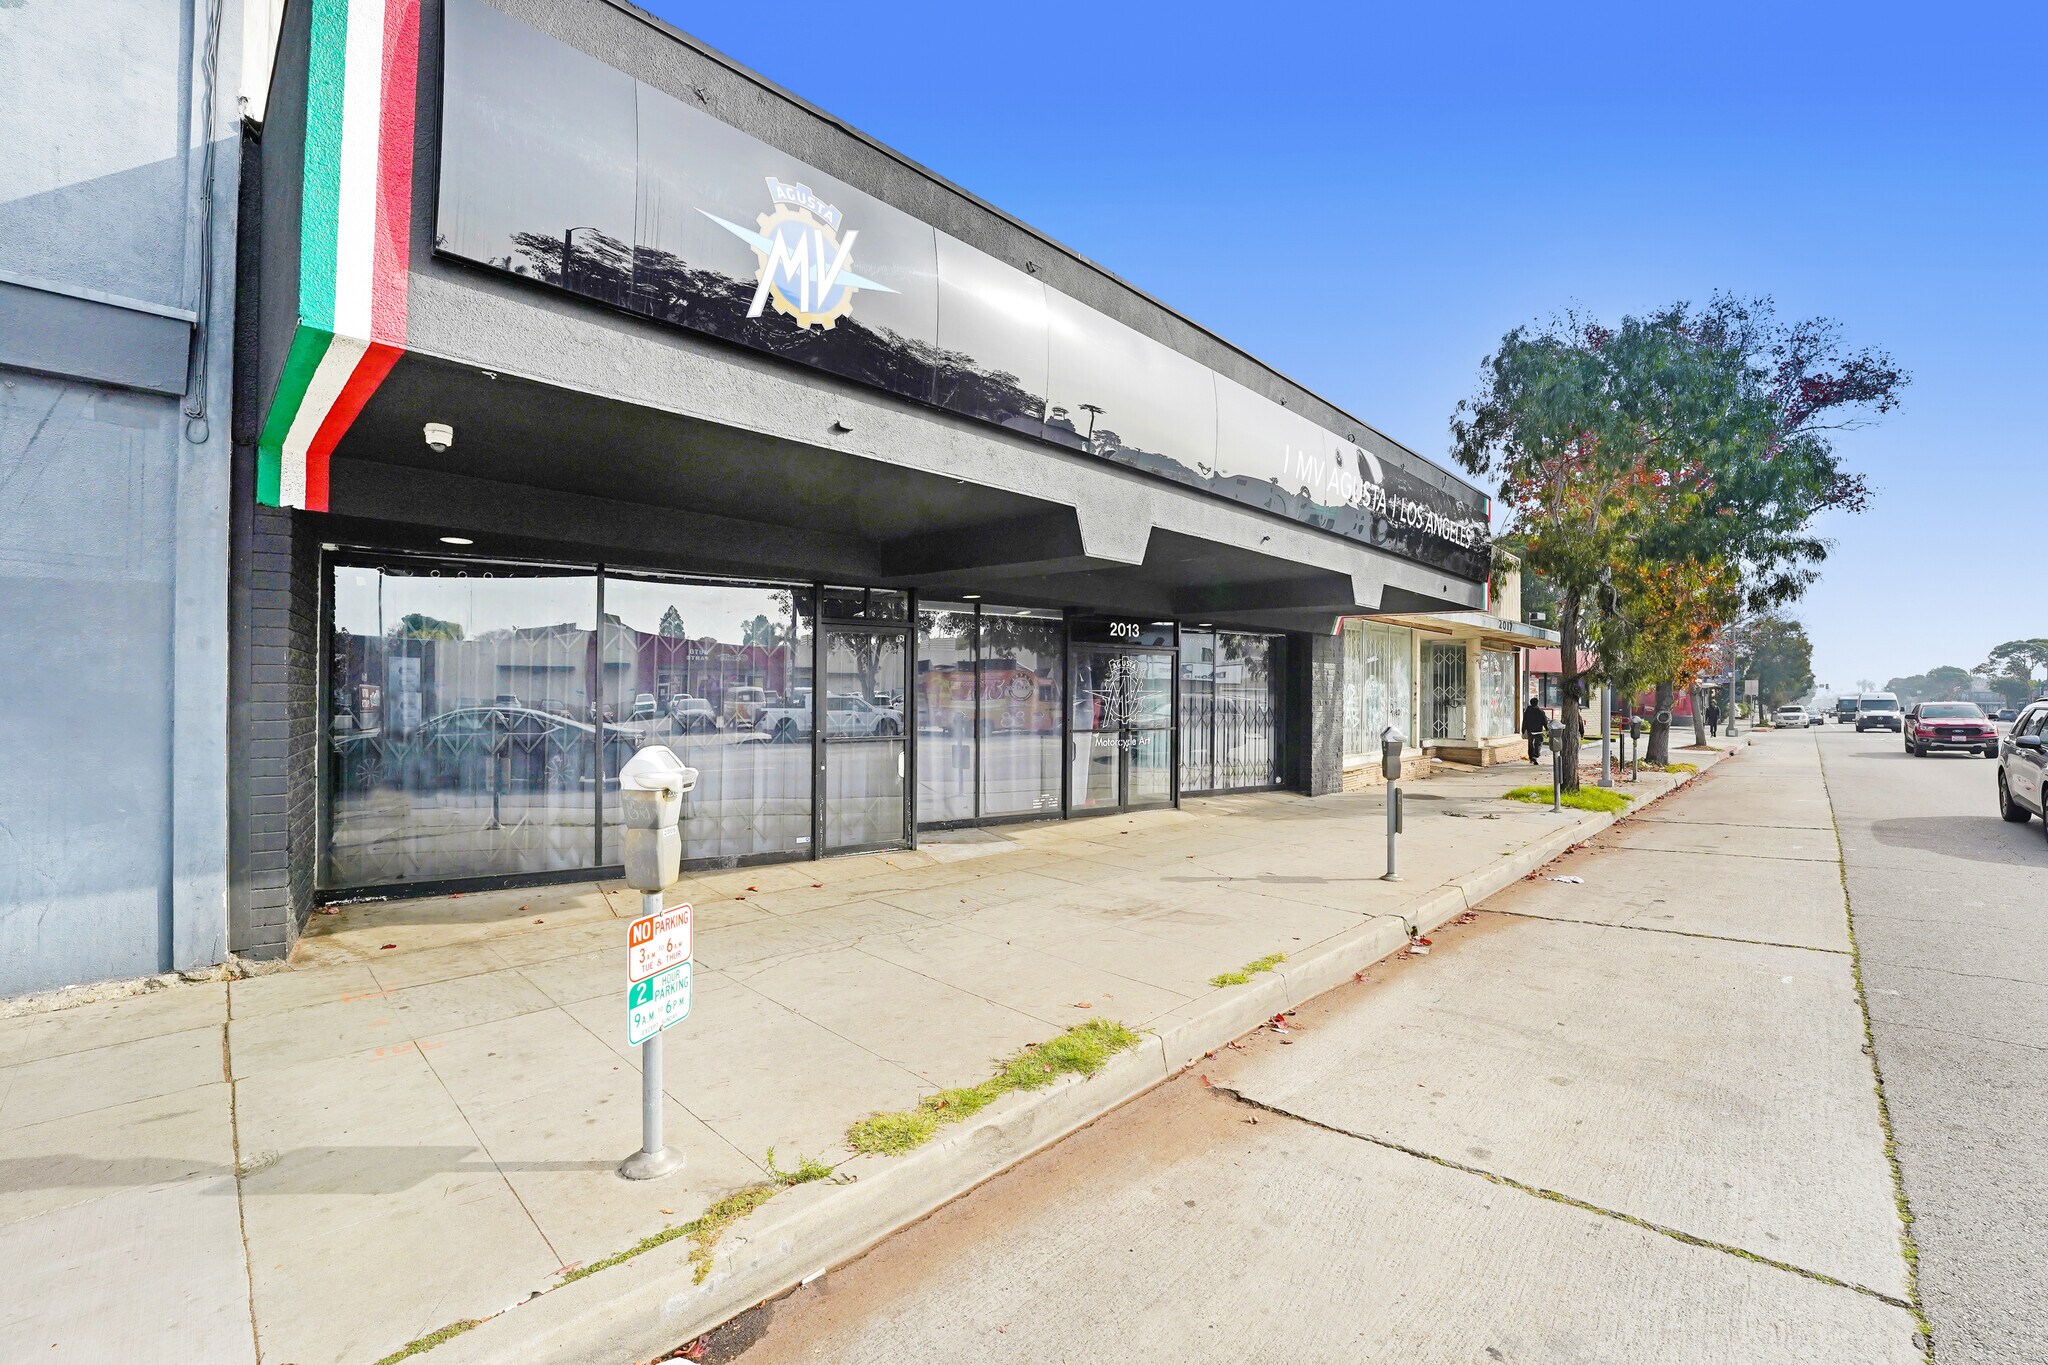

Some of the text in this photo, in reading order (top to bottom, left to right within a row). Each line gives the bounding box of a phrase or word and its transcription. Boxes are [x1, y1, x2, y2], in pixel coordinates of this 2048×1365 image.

[775, 185, 834, 224] AGUSTA
[746, 229, 860, 319] MV
[1295, 450, 1326, 487] MV
[1326, 467, 1388, 515] AGUSTA
[1399, 497, 1425, 529] LOS
[1424, 511, 1472, 549] ANGELES
[1109, 622, 1140, 638] 2013
[1138, 736, 1151, 746] Art
[633, 911, 689, 944] NO PARKING
[642, 950, 682, 973] TUE & THUR
[636, 969, 681, 1005] 2 HOUR
[654, 976, 689, 1002] PARKING
